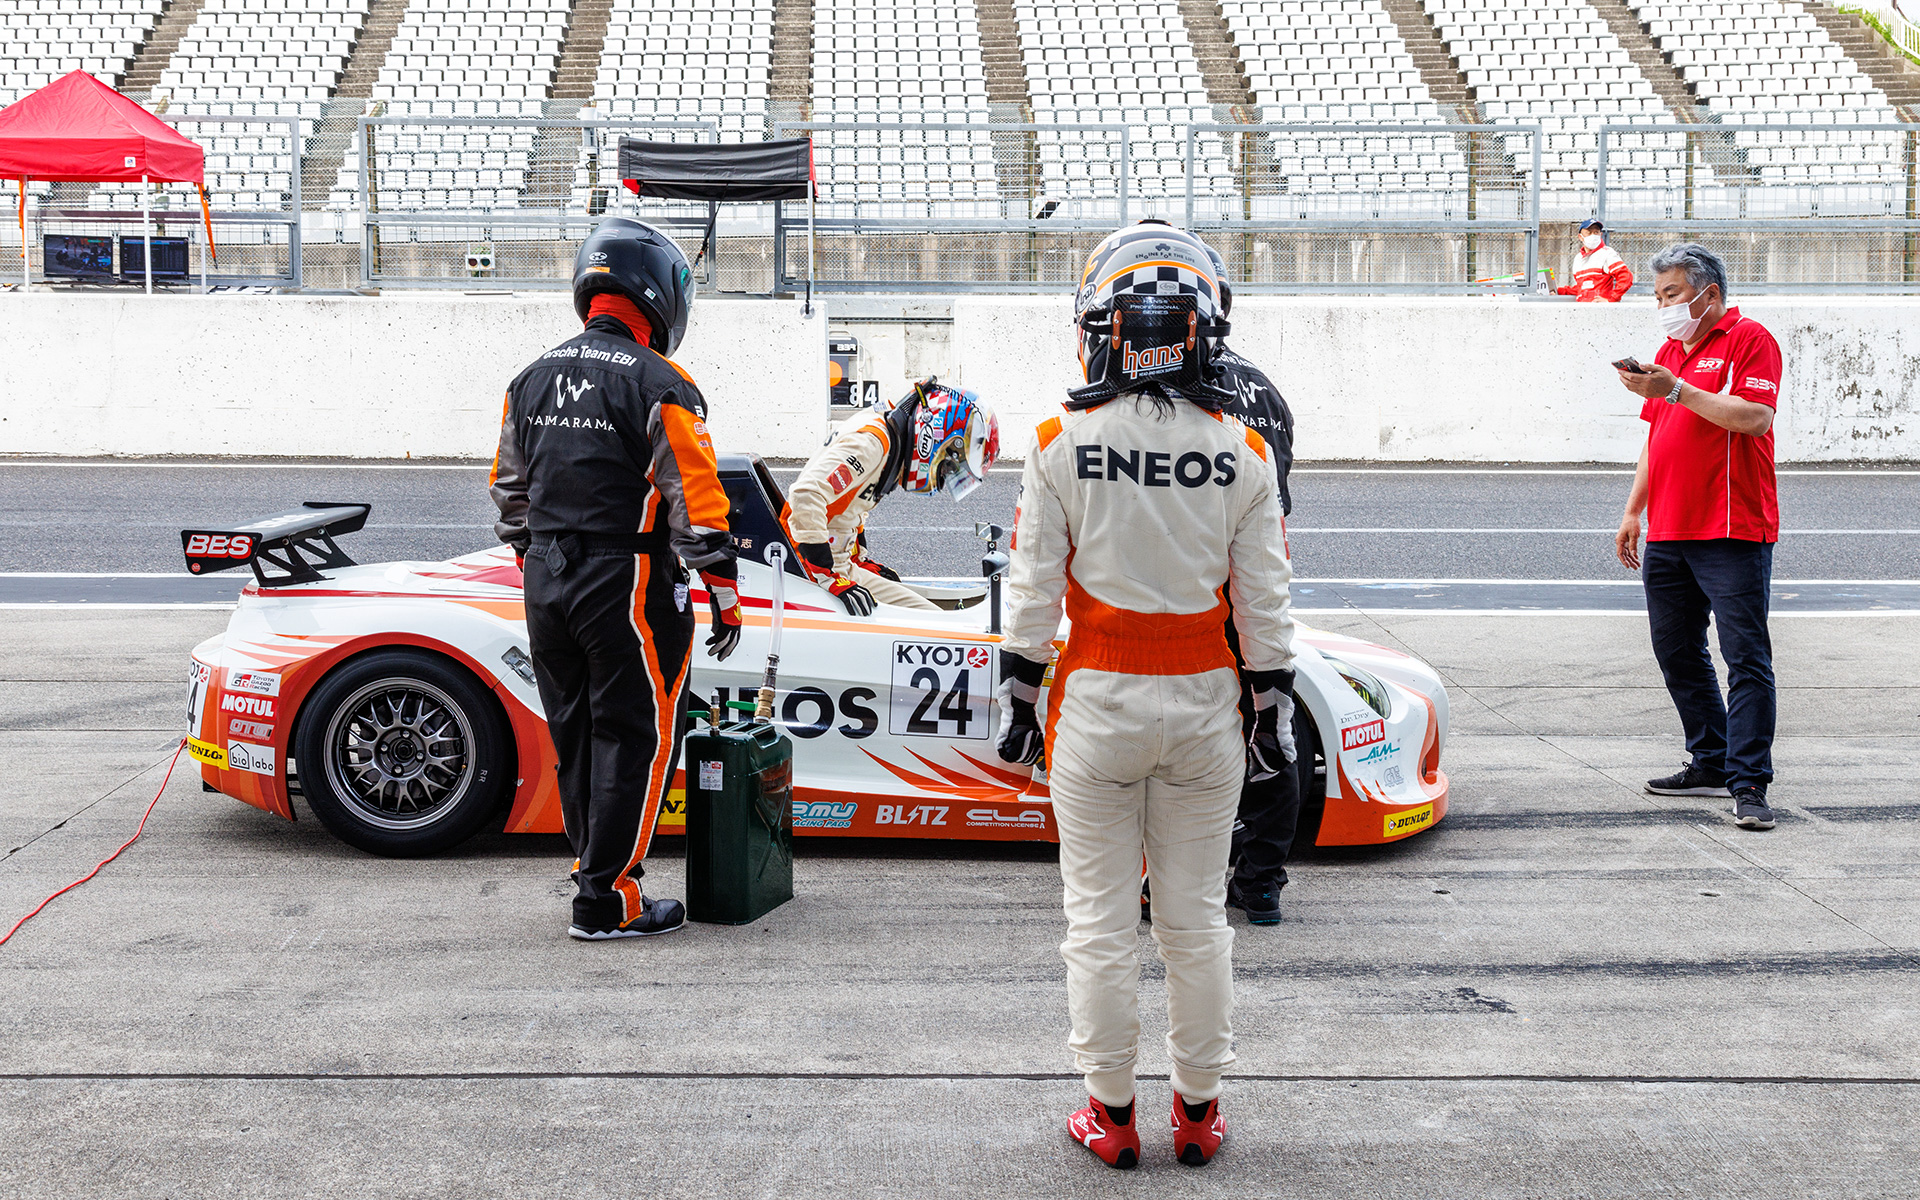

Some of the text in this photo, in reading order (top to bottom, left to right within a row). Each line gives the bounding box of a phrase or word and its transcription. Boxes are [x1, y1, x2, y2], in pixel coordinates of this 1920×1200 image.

[543, 345, 637, 367] orsche Team EBI
[1122, 340, 1185, 380] hans
[1696, 359, 1723, 369] SRT
[923, 424, 933, 457] Arai
[1075, 444, 1237, 489] ENEOS
[186, 534, 253, 558] BBS
[249, 684, 270, 693] Racing
[253, 675, 275, 683] TOYOTA
[221, 693, 275, 718] MOTUL
[906, 667, 973, 736] 24
[1344, 721, 1384, 749] MOTUL
[231, 752, 274, 771] bio labo
[824, 820, 851, 828] PADS
[875, 804, 950, 826] BLITZ
[966, 809, 1046, 823] CLA
[1396, 810, 1431, 829] DUNLOP
